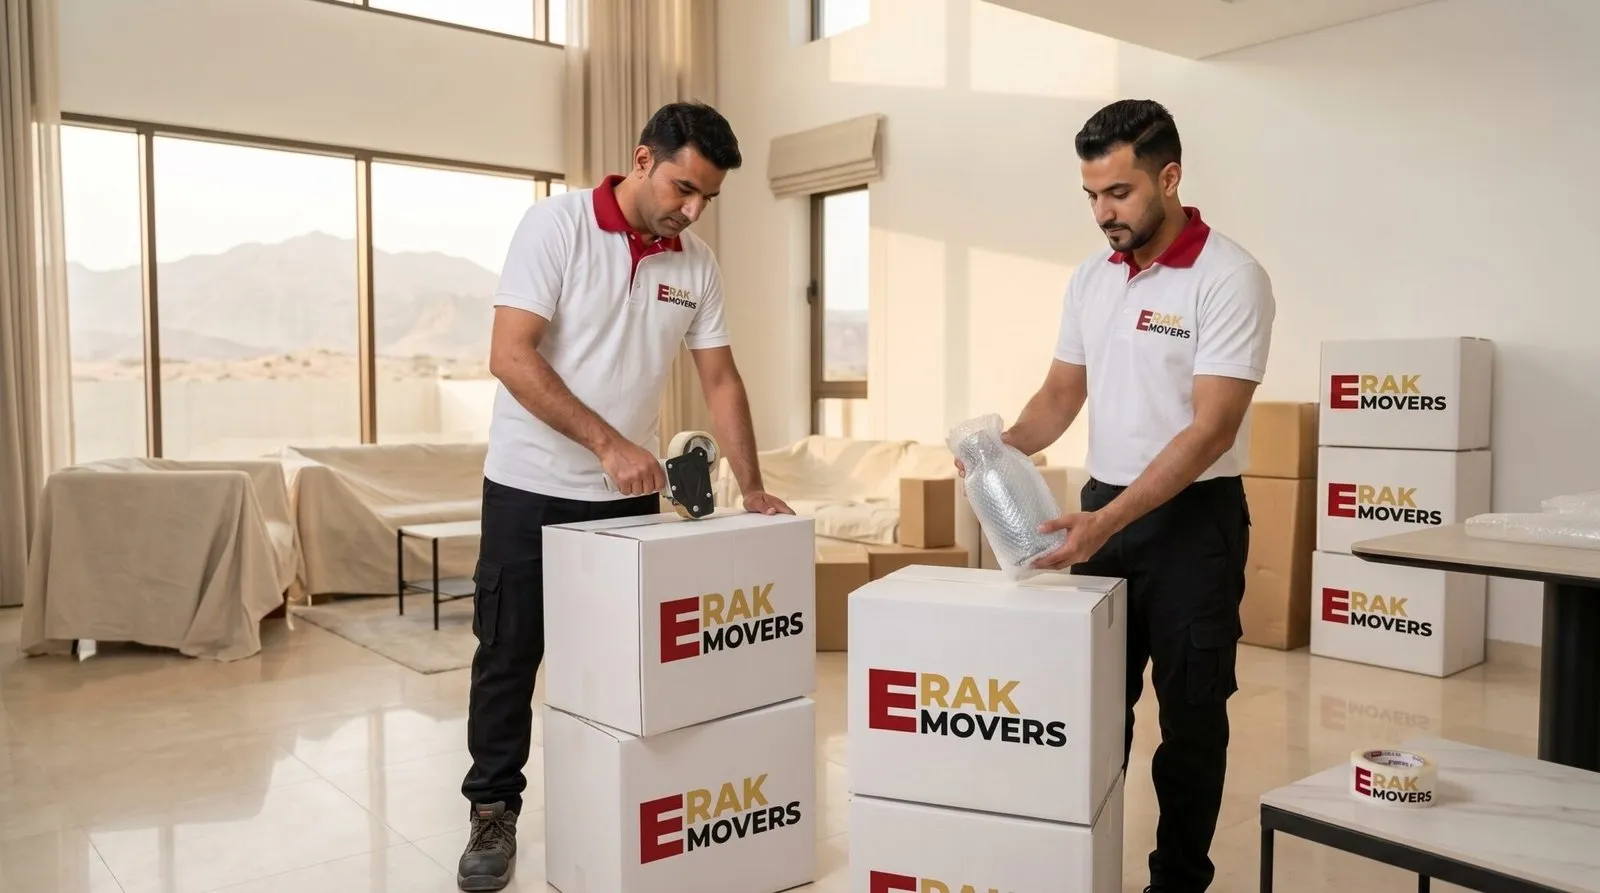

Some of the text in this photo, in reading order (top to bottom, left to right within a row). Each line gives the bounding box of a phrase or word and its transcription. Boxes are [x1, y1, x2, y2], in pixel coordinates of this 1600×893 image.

[669, 287, 690, 299] RAK
[669, 297, 697, 309] MOVERS
[1152, 312, 1184, 327] RAK
[1148, 324, 1191, 338] MOVERS
[1361, 375, 1421, 394] RAK
[1361, 395, 1446, 410] MOVERS
[1358, 485, 1417, 507] RAK
[1358, 505, 1442, 525] MOVERS
[703, 583, 775, 628] RAK
[1351, 591, 1408, 616] RAK
[703, 612, 804, 654] MOVERS
[1351, 612, 1432, 637] MOVERS
[920, 672, 1021, 714] RAK
[920, 709, 1067, 747] MOVERS
[1374, 773, 1418, 791] RAK
[687, 773, 769, 825] RAK
[1373, 788, 1432, 803] MOVERS
[688, 801, 801, 852] MOVERS
